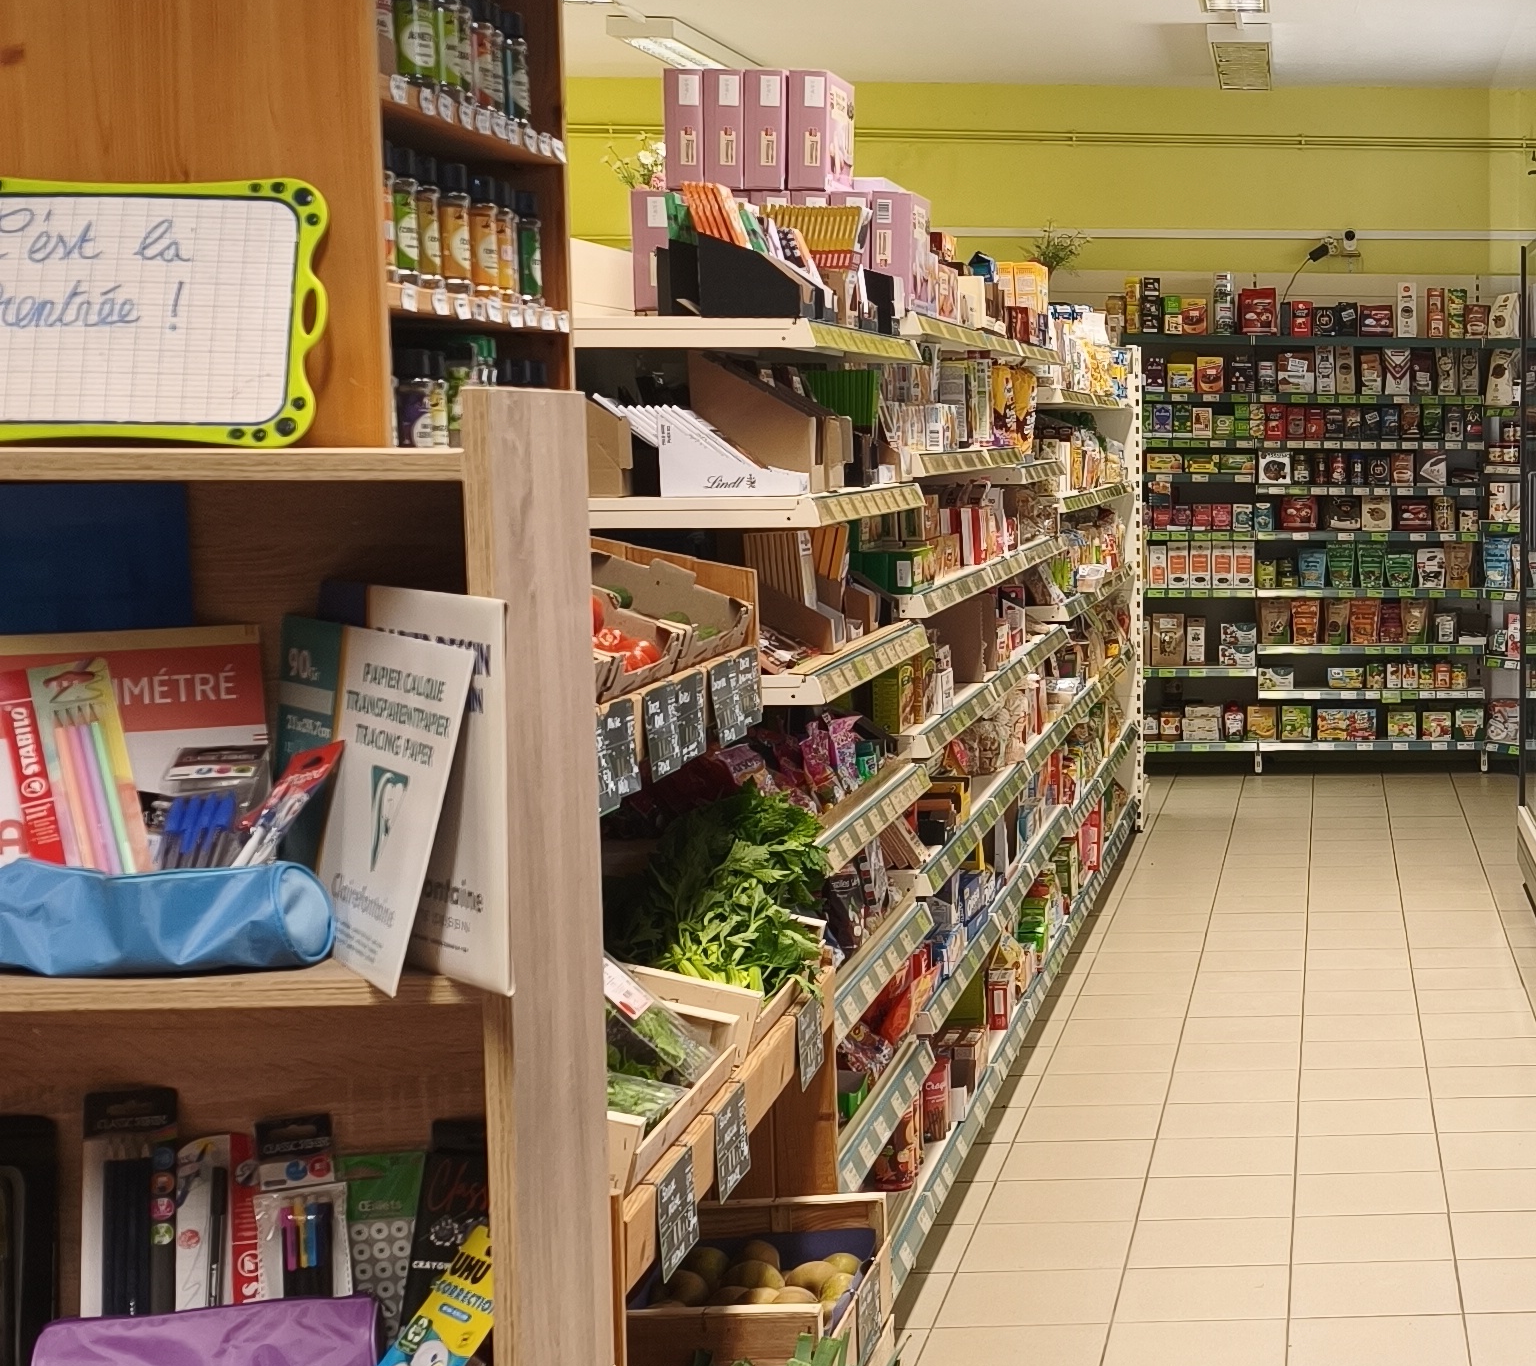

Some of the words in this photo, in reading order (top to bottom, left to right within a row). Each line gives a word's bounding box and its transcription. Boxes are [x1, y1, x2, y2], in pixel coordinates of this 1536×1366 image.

[133, 218, 192, 262] la
[168, 280, 185, 332] !
[703, 474, 745, 489] Lindt
[10, 706, 41, 776] STABILO
[451, 1249, 493, 1285] UHU
